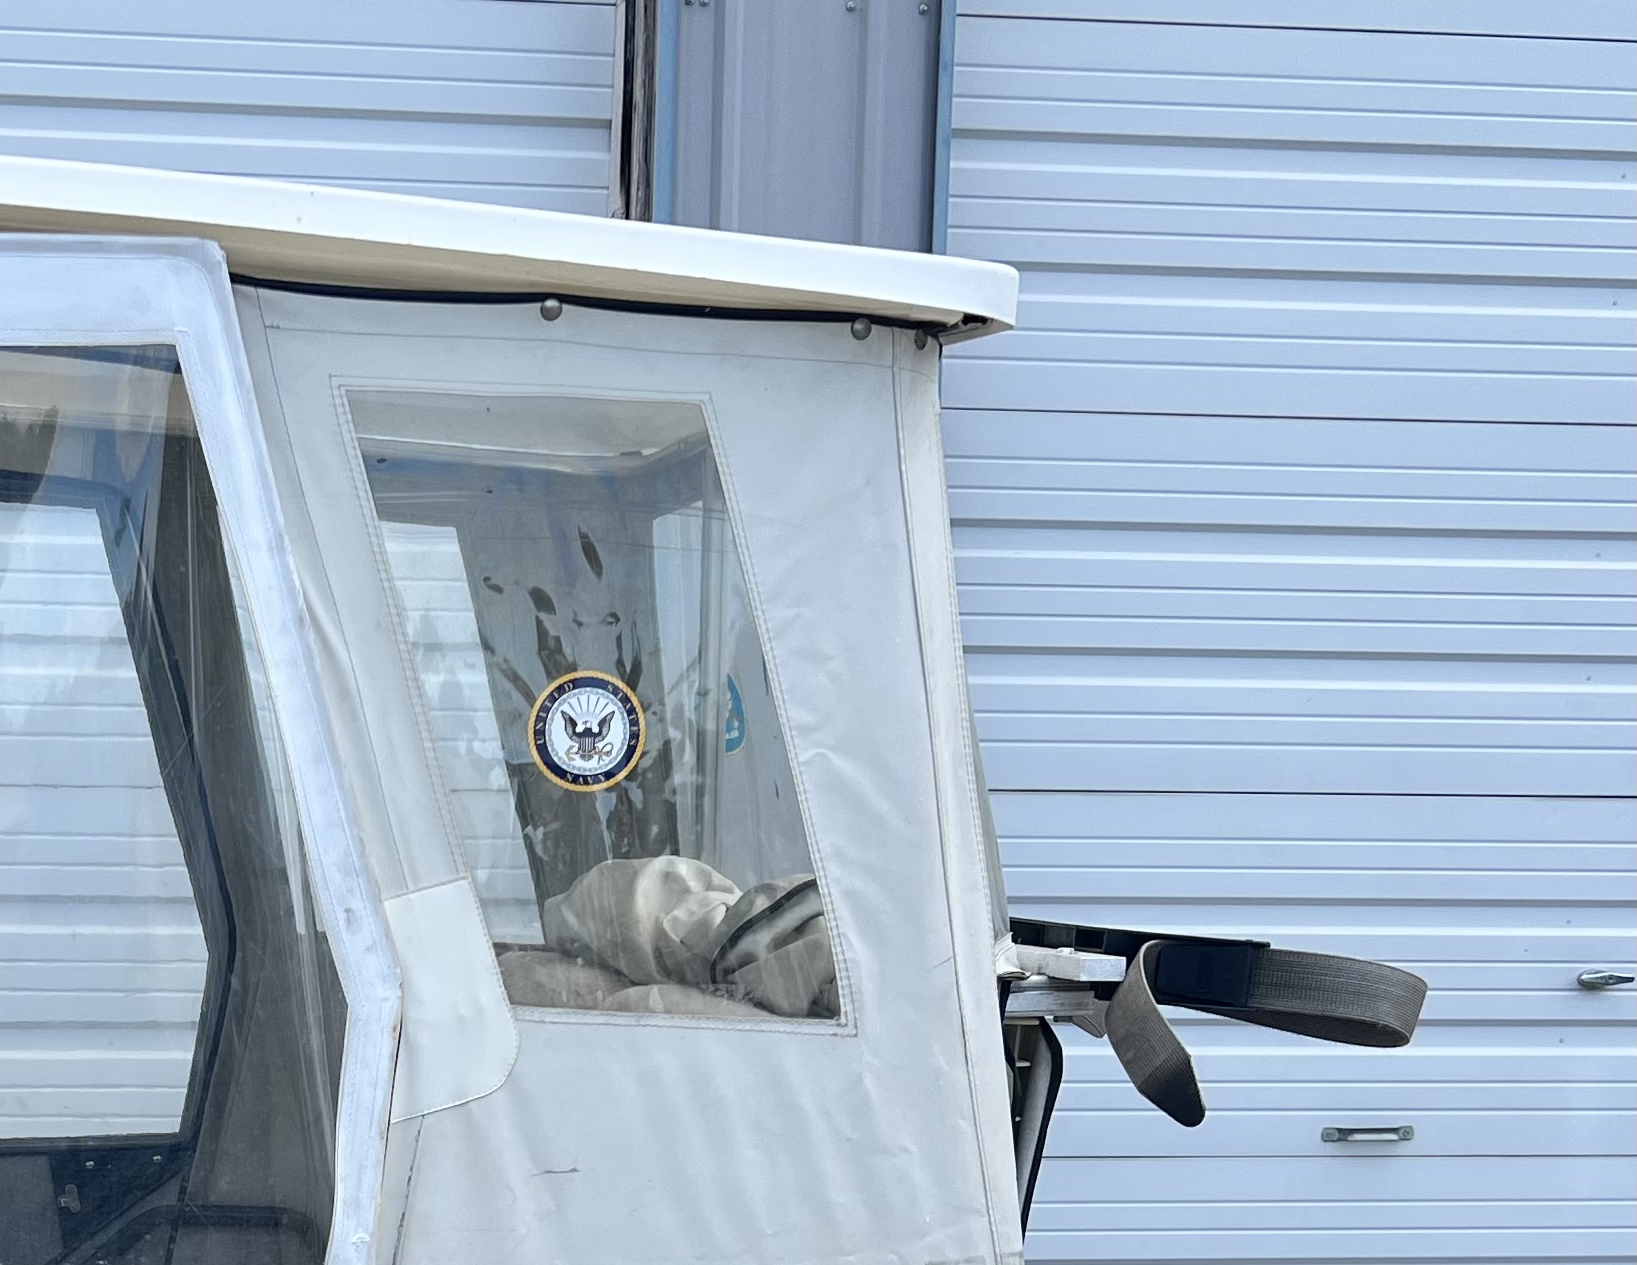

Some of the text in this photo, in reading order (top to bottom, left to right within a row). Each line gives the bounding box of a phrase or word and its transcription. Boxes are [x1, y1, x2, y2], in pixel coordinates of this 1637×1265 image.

[535, 682, 639, 746] UNITED STATES
[564, 773, 606, 785] NAVY
